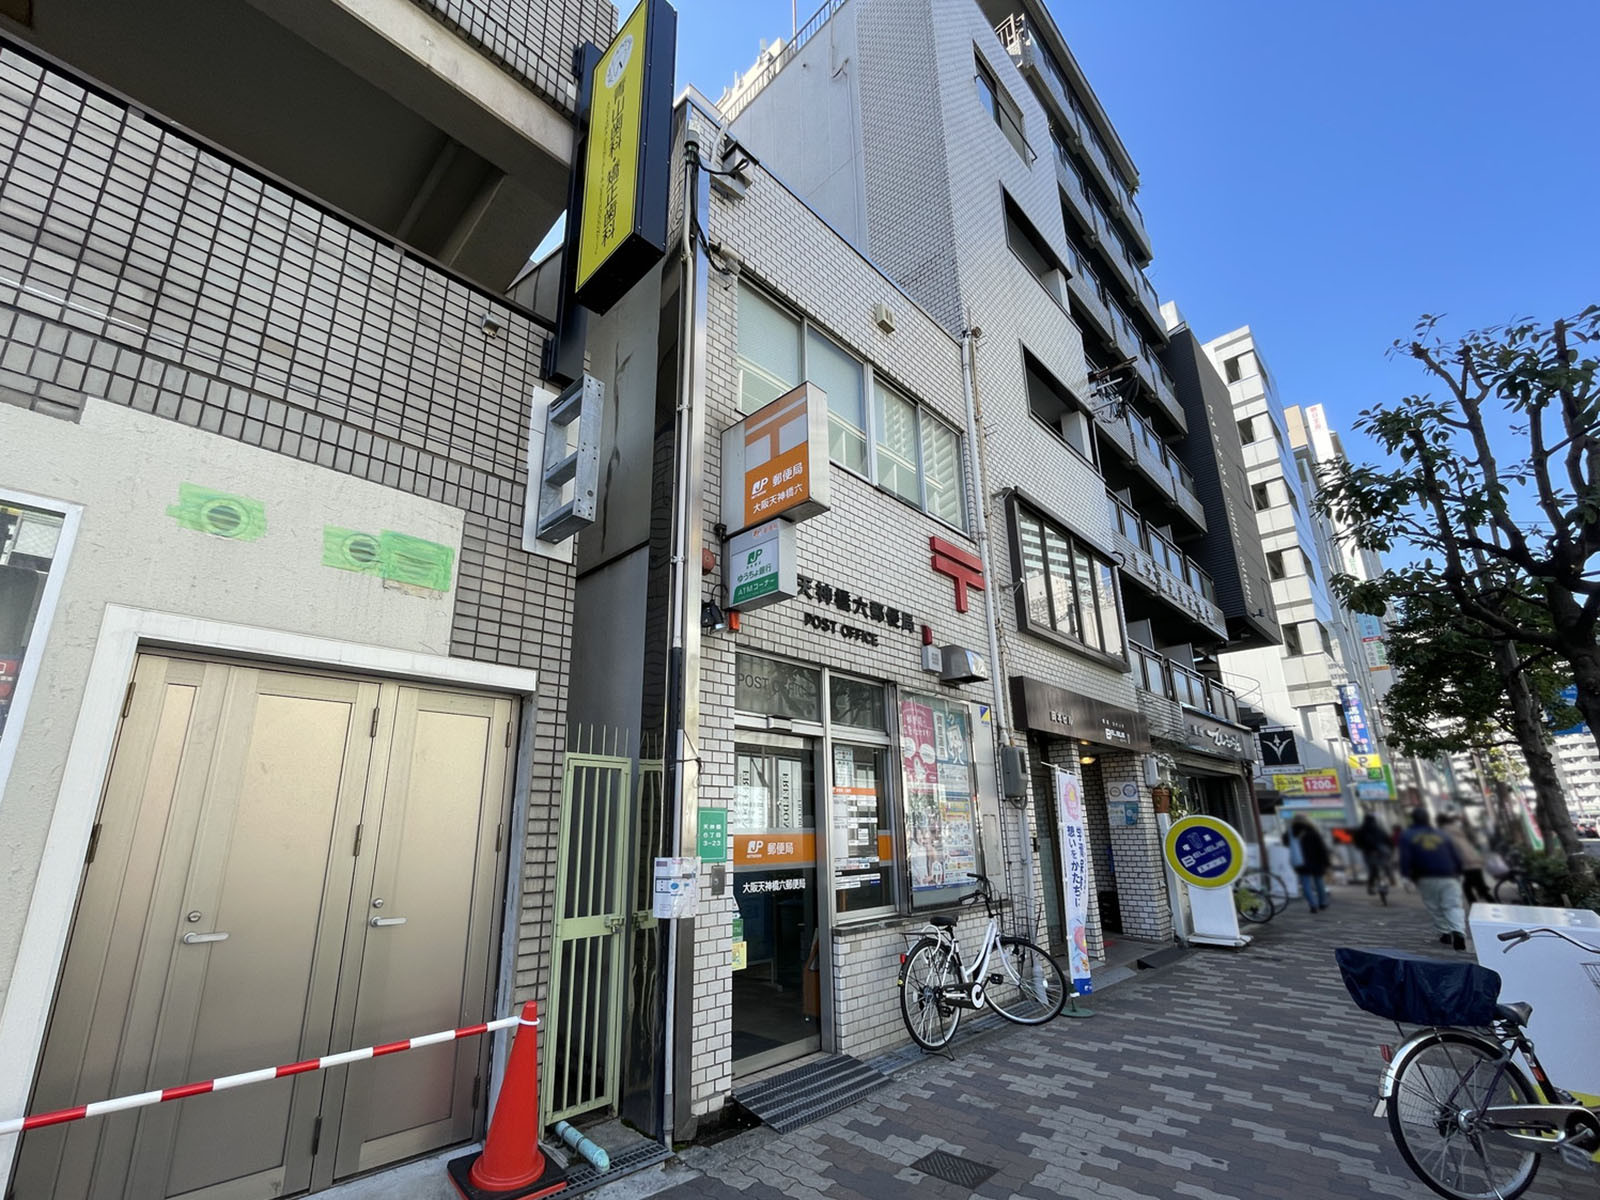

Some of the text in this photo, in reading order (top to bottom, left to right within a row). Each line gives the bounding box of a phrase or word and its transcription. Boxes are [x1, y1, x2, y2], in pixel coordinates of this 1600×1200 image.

[773, 462, 803, 487] 郵便局
[753, 484, 803, 514] 大阪天神橋六
[737, 563, 772, 583] ゆうちょ銀行
[803, 612, 880, 648] POST OFFICE
[737, 673, 769, 689] POST
[767, 842, 794, 855] 郵便局
[742, 878, 806, 894] 大阪天神橋六郵便局
